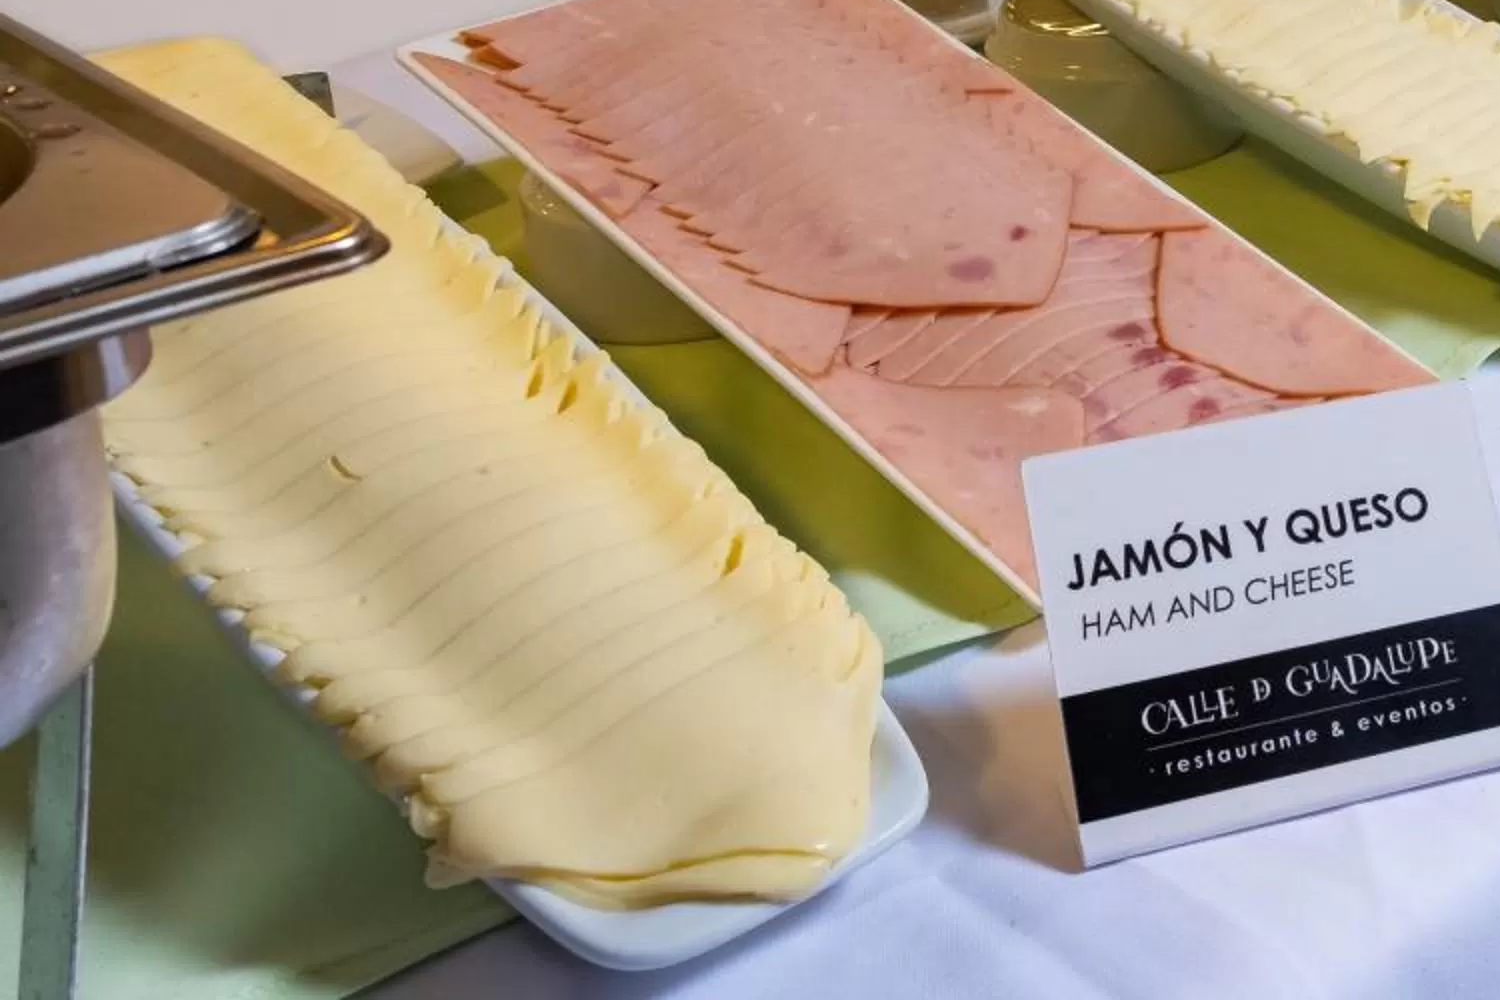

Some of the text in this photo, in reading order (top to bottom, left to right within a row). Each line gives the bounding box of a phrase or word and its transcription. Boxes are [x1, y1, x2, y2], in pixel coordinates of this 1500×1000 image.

[1067, 487, 1429, 590] JAMÓN Y QUESO
[1082, 560, 1355, 640] HAM AND CHEESE
[1141, 686, 1239, 735] CALLE
[1286, 637, 1459, 697] GUADALUPE
[1165, 697, 1456, 776] restaurante & eventos
